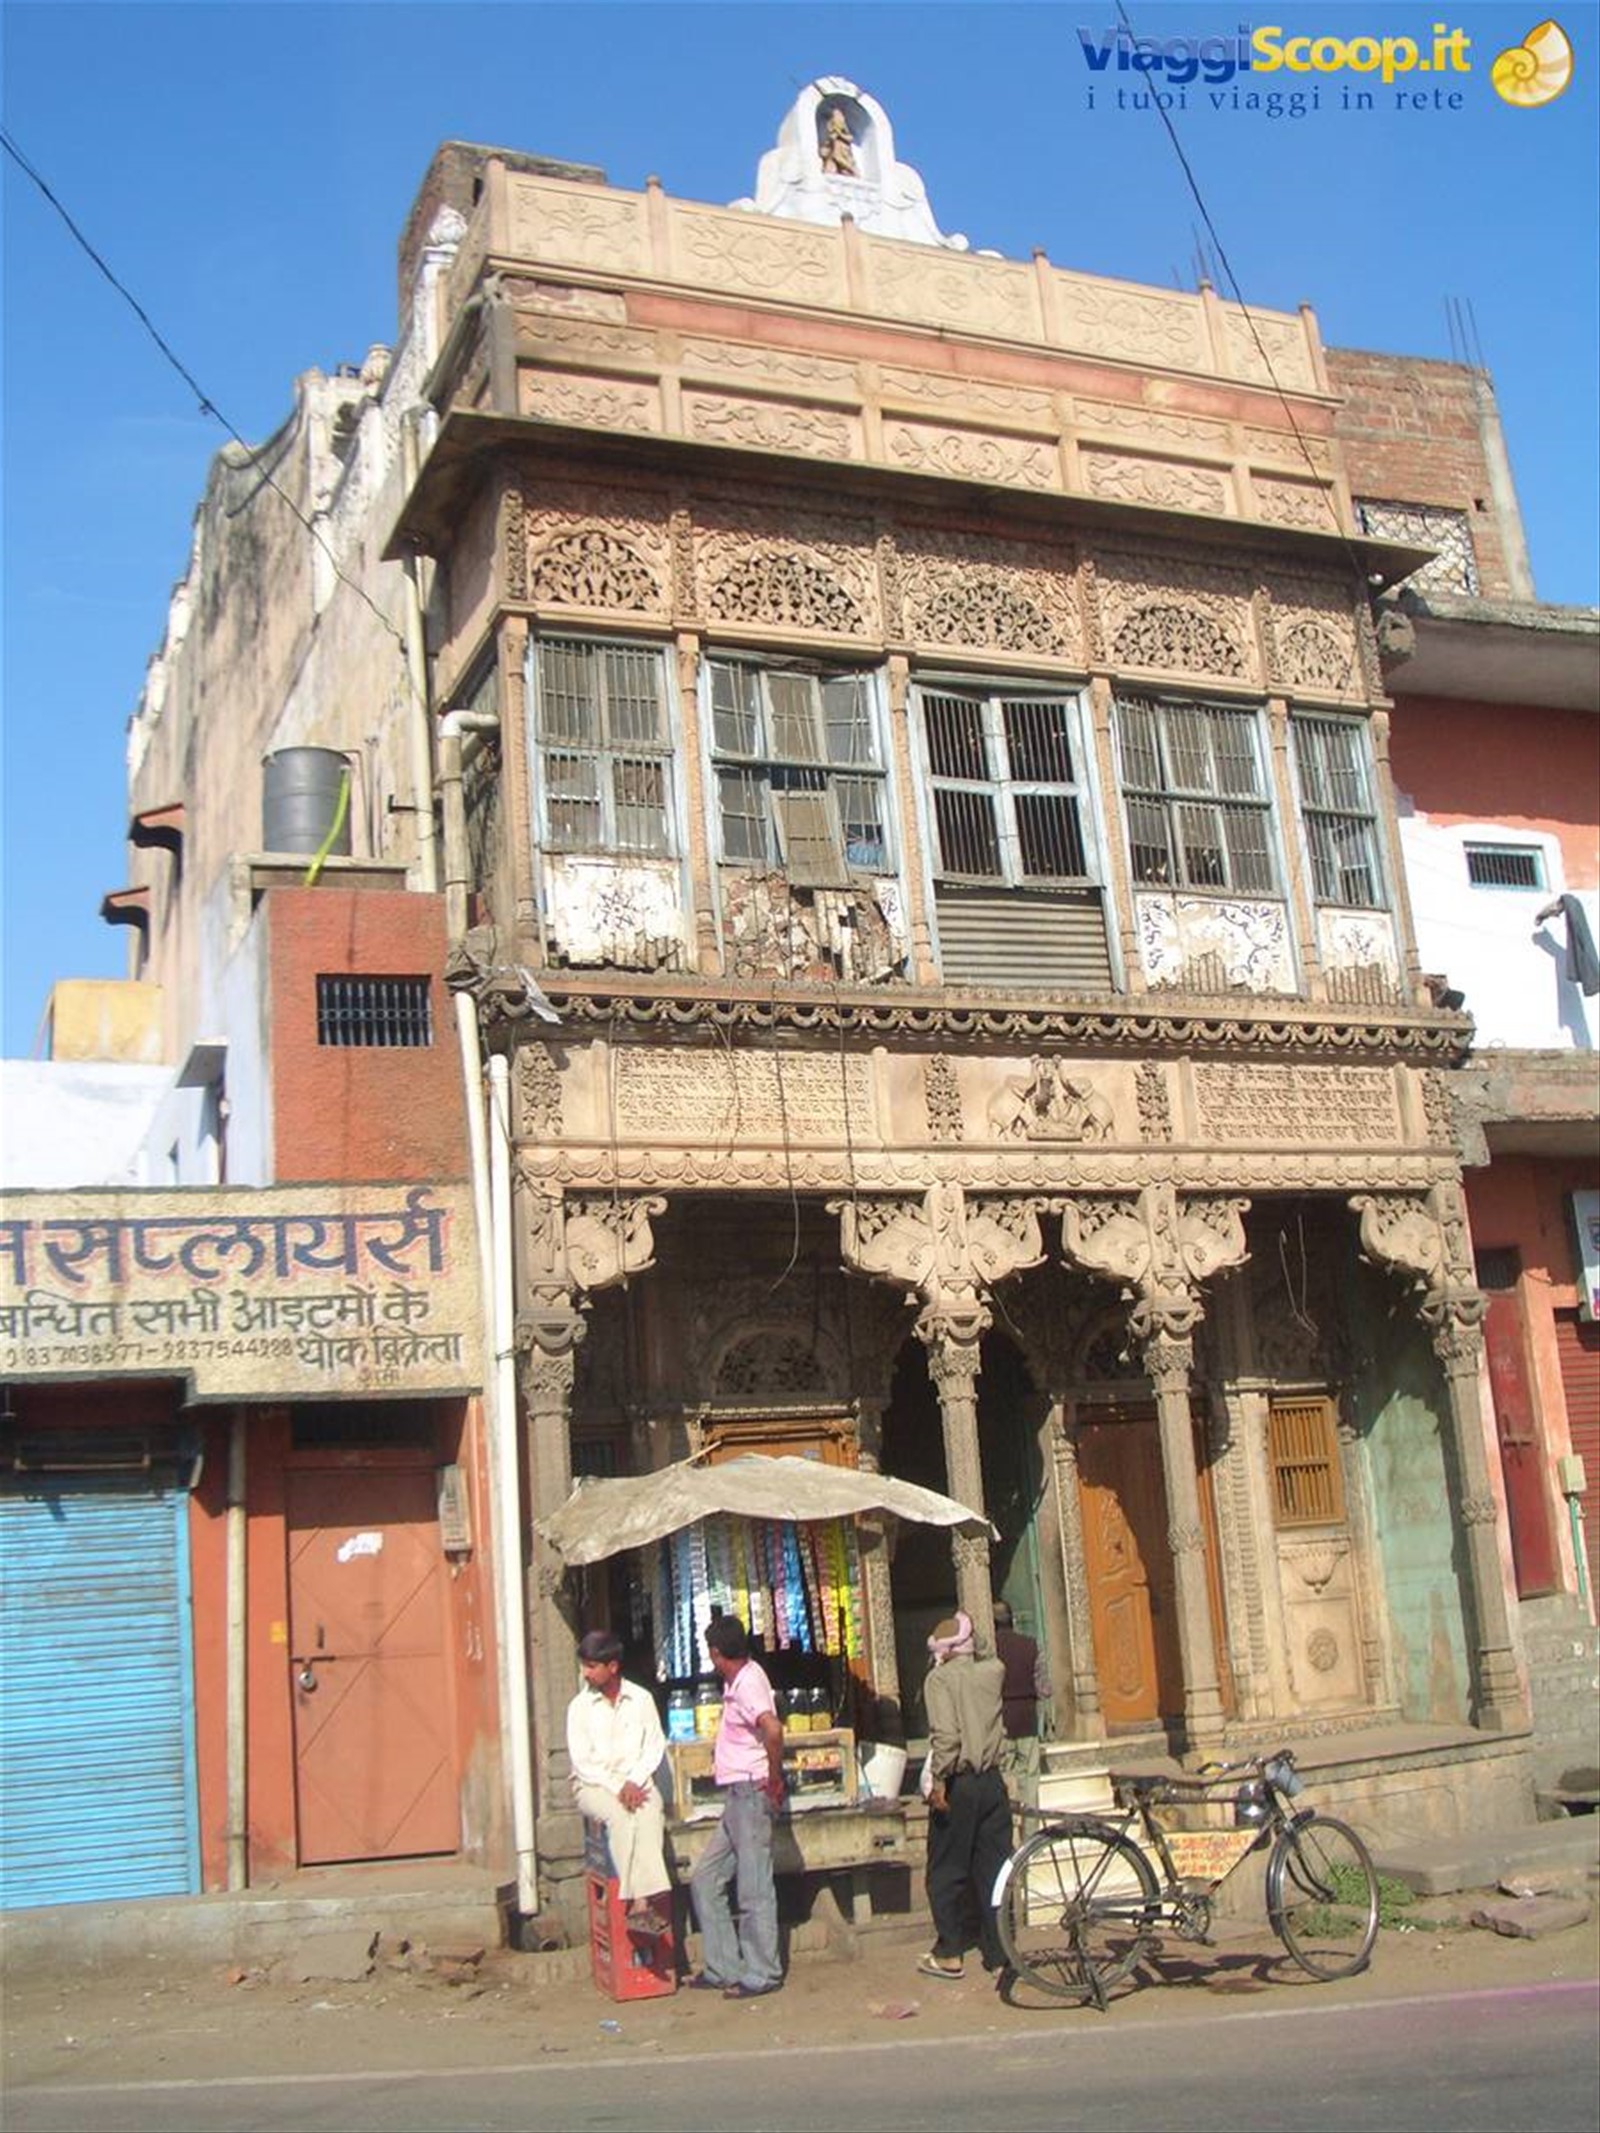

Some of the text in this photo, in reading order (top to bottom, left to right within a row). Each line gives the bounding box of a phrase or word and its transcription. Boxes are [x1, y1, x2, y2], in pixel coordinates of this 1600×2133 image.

[43, 1187, 446, 1284] सप्लायर्स
[129, 1289, 219, 1336] सभी
[383, 1281, 429, 1325] के
